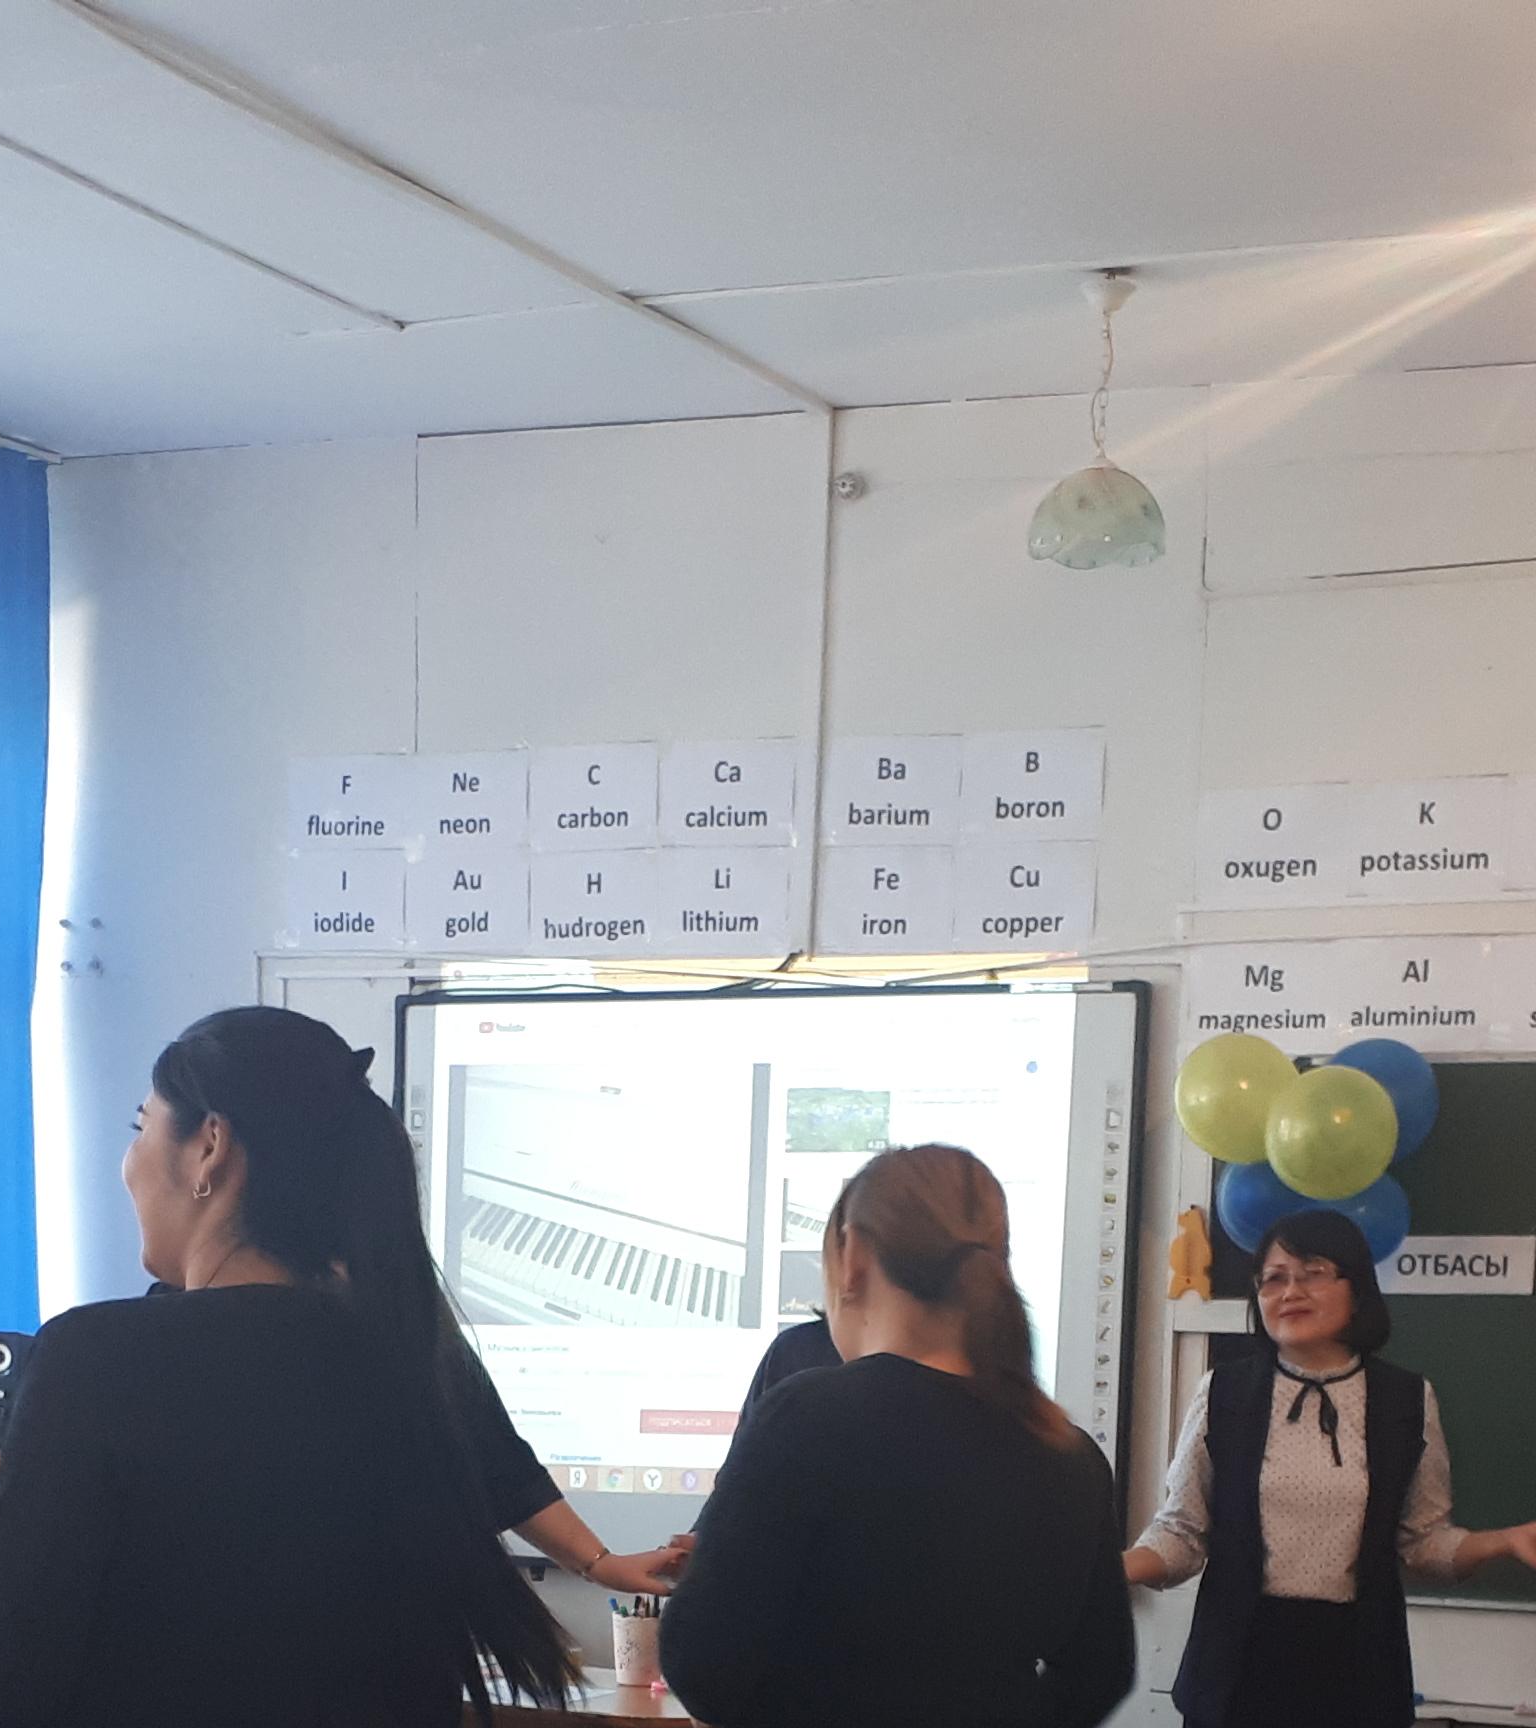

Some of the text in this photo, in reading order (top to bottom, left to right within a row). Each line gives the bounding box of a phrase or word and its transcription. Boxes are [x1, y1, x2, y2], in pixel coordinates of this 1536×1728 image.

[714, 760, 741, 783] Ca
[877, 757, 907, 781] Ba
[1025, 751, 1040, 773] B
[341, 775, 352, 795] F
[452, 772, 480, 793] Ne
[587, 764, 601, 786] C
[557, 806, 629, 829] carbon
[685, 805, 768, 828] calcium
[848, 802, 930, 826] barium
[995, 796, 1065, 820] boron
[1262, 807, 1283, 831] O
[1419, 801, 1436, 825] K
[307, 814, 385, 836] fluorine
[439, 818, 491, 835] neon
[1224, 858, 1317, 883] oxugen
[1360, 847, 1489, 877] potassium
[341, 870, 347, 891] I
[452, 869, 482, 891] Au
[587, 872, 602, 895] H
[714, 867, 731, 890] Li
[873, 867, 900, 891] Fe
[1009, 864, 1040, 889] Cu
[314, 911, 375, 933] iodide
[444, 911, 489, 938] gold
[543, 916, 645, 942] hudrogen
[682, 909, 759, 932] lithium
[862, 913, 907, 935] iron
[982, 916, 1064, 939] copper
[1244, 964, 1284, 993] Mg
[1402, 959, 1430, 983] Al
[1198, 1008, 1326, 1034] magnesium
[1350, 1005, 1476, 1027] aluminium
[1396, 1253, 1509, 1278] ОТБАСЫ
